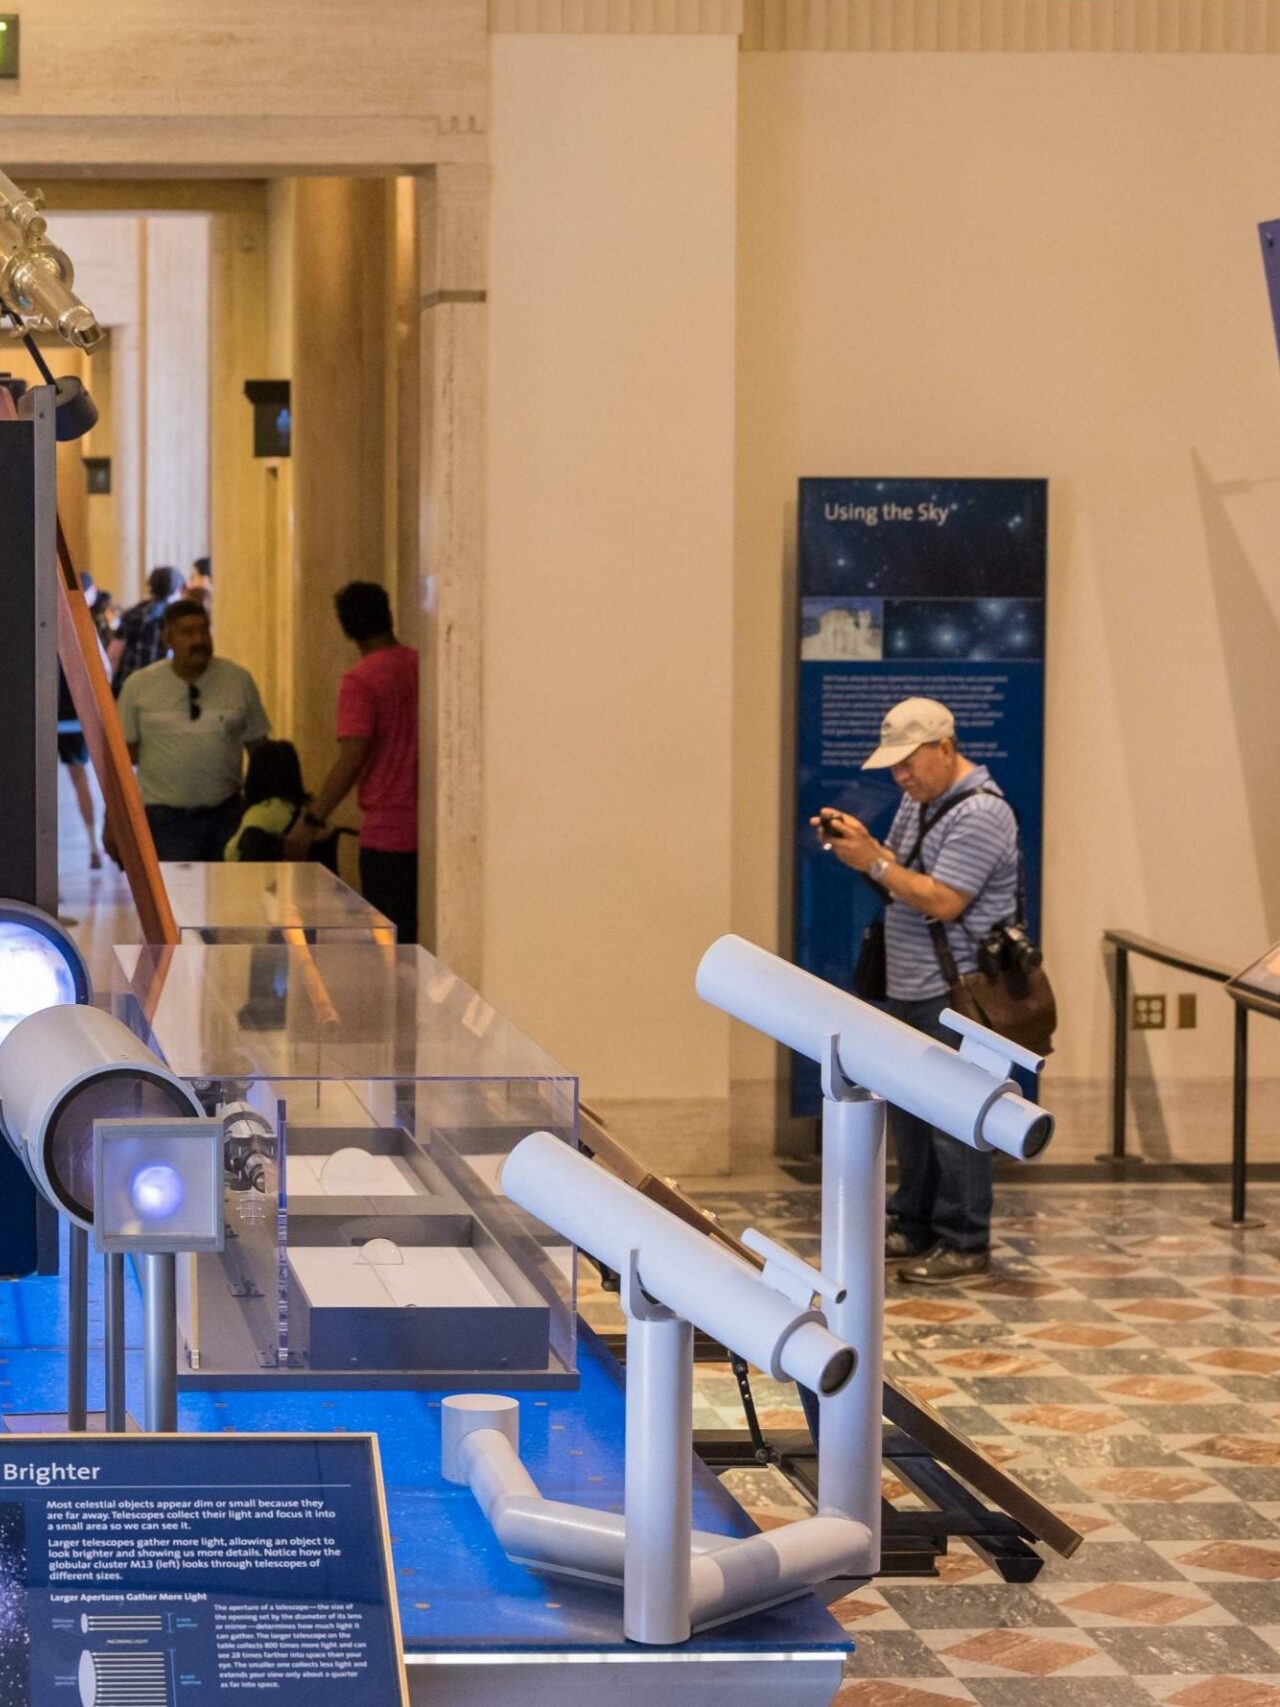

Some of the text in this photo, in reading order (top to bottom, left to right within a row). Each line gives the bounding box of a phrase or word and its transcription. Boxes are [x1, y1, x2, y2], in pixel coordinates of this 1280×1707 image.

[824, 502, 949, 526] Using the Sky
[3, 1463, 100, 1485] Brighter
[74, 1500, 116, 1508] celestial
[118, 1500, 154, 1510] objects
[156, 1501, 191, 1510] appear
[193, 1499, 213, 1508] dim
[228, 1499, 256, 1508] small
[258, 1499, 298, 1507] because
[300, 1499, 323, 1509] they
[65, 1511, 80, 1519] far
[82, 1511, 110, 1521] away.
[111, 1510, 164, 1521] Telescopes
[166, 1510, 199, 1518] collect
[202, 1510, 226, 1518] their
[228, 1510, 252, 1520] light
[254, 1510, 273, 1518] and
[275, 1510, 303, 1518] focus
[305, 1510, 312, 1518] it
[315, 1510, 336, 1518] into
[55, 1522, 83, 1530] small
[85, 1522, 108, 1530] area
[110, 1522, 121, 1530] so
[123, 1522, 139, 1530] we
[141, 1522, 159, 1530] can
[180, 1521, 191, 1529] it.
[48, 1538, 79, 1548] Larger
[81, 1538, 134, 1548] telescopes
[136, 1537, 170, 1548] gather
[201, 1536, 227, 1547] light,
[229, 1537, 273, 1547] allowing
[289, 1536, 322, 1547] object
[323, 1537, 335, 1545] to
[48, 1549, 70, 1558] look
[72, 1549, 113, 1559] brighter
[116, 1549, 135, 1557] and
[137, 1549, 181, 1559] showing
[197, 1549, 224, 1557] more
[225, 1548, 262, 1557] details.
[264, 1548, 297, 1556] Notice
[299, 1548, 321, 1556] how
[323, 1548, 341, 1556] the
[48, 1559, 320, 1571] globular cluster M13 (left) looks through telescopes of
[49, 1571, 123, 1580] different sizes.
[50, 1593, 78, 1602] Larger
[80, 1593, 124, 1603] Apertures
[126, 1593, 157, 1601] Gather
[184, 1592, 207, 1602] Light
